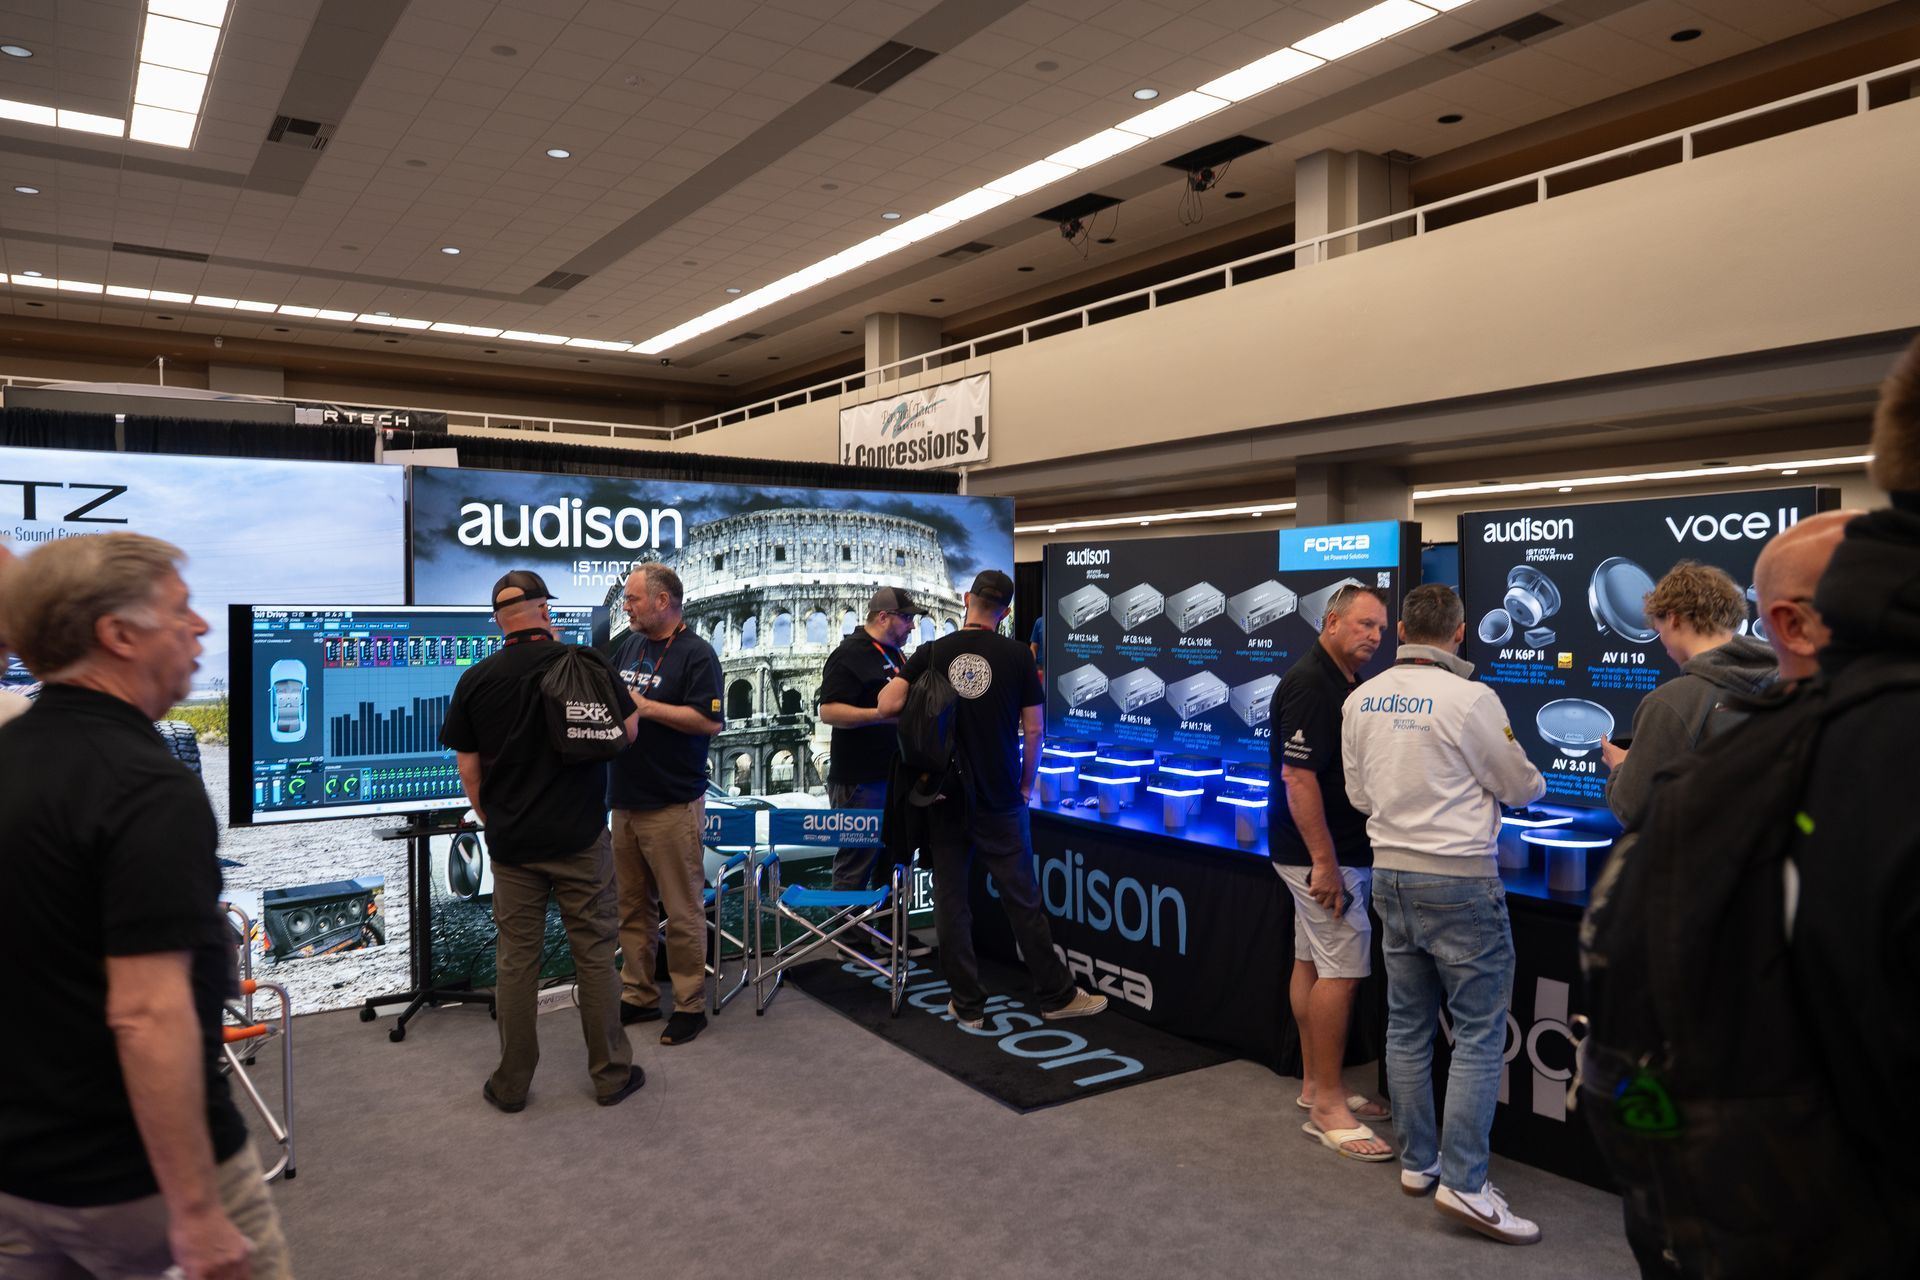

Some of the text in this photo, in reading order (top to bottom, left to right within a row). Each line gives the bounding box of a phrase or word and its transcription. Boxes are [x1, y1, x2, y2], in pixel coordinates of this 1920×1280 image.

[324, 410, 409, 427] RTECH
[855, 429, 969, 468] Concessions
[457, 497, 683, 549] audison
[15, 526, 54, 542] Sound
[1483, 517, 1574, 543] audison
[1304, 534, 1370, 552] FORZA
[1066, 547, 1110, 565] audison
[1525, 547, 1556, 555] ISTINTO
[1525, 553, 1574, 561] INNOVATIVO
[573, 574, 629, 586] INNOV
[1122, 635, 1130, 643] AF
[1144, 636, 1152, 644] bit
[1179, 637, 1187, 646] AF
[1203, 638, 1212, 647] bit
[1248, 639, 1257, 648] AF
[1499, 648, 1544, 661] AV K6P II
[1602, 652, 1645, 664] AV II 10
[1587, 665, 1604, 673] Power
[1360, 694, 1433, 715] audison
[1069, 708, 1075, 716] AF
[1120, 713, 1151, 726] AF M5.11 bit
[1180, 721, 1212, 732] AF M1.7 bit
[1254, 728, 1262, 737] AF
[1552, 758, 1596, 773] AV 3.0 II
[803, 813, 879, 831] audison
[986, 849, 1187, 956] dison
[1016, 941, 1154, 1011] RZA
